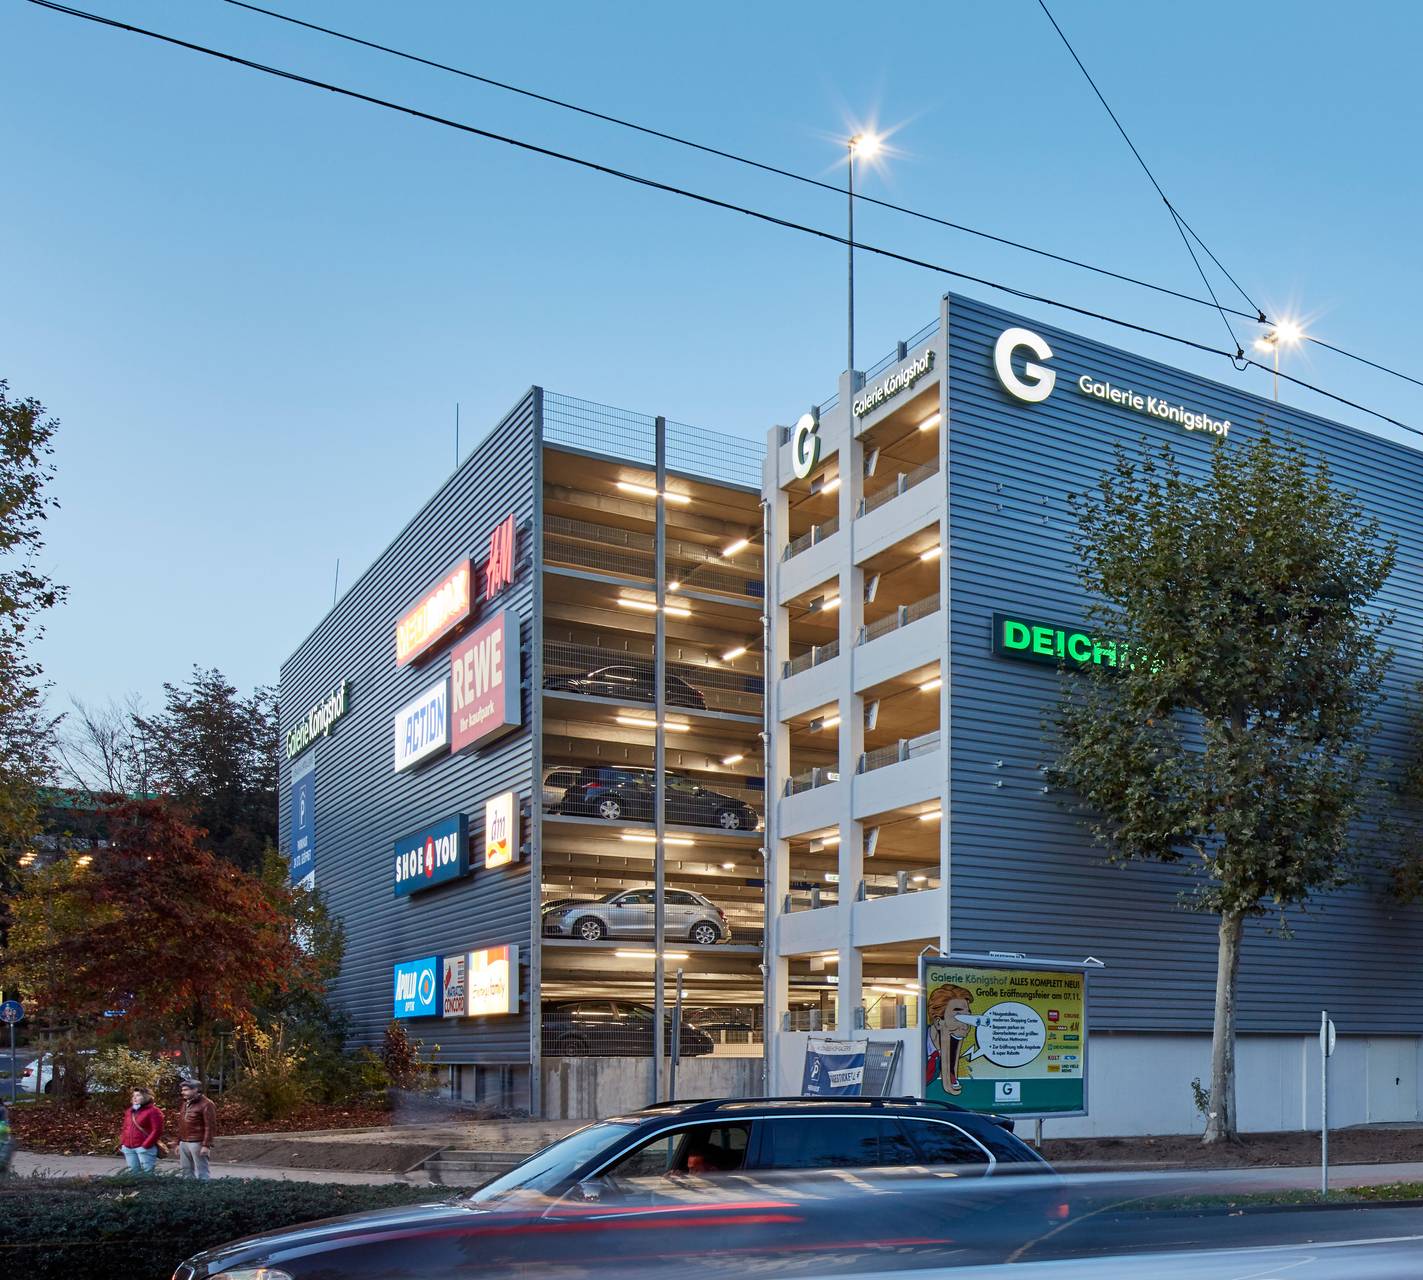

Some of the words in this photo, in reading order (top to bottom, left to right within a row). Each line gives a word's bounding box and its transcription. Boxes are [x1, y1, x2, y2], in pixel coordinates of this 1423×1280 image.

[852, 387, 884, 418] Galerie
[884, 349, 931, 398] Königshof
[993, 327, 1056, 403] G
[1079, 375, 1144, 410] Galerie
[1147, 395, 1231, 437] Königshof
[792, 413, 817, 479] G
[453, 628, 503, 713] REWE
[287, 717, 309, 759] Galerie
[309, 679, 345, 740] Königshof
[404, 692, 444, 758] ACTION
[491, 809, 506, 841] dm
[396, 847, 423, 882] SHOE
[426, 843, 433, 870] 4
[435, 832, 457, 867] YOU
[445, 997, 464, 1013] CONCORD
[931, 972, 963, 983] Galerie
[965, 974, 1008, 986] Königshof
[1010, 977, 1029, 986] ALLES
[1030, 978, 1064, 988] KOMPLETT
[1065, 979, 1080, 989] NEU!
[976, 988, 998, 997] Große
[1000, 989, 1050, 1000] Eröffnungsfeier
[1003, 1083, 1013, 1096] G
